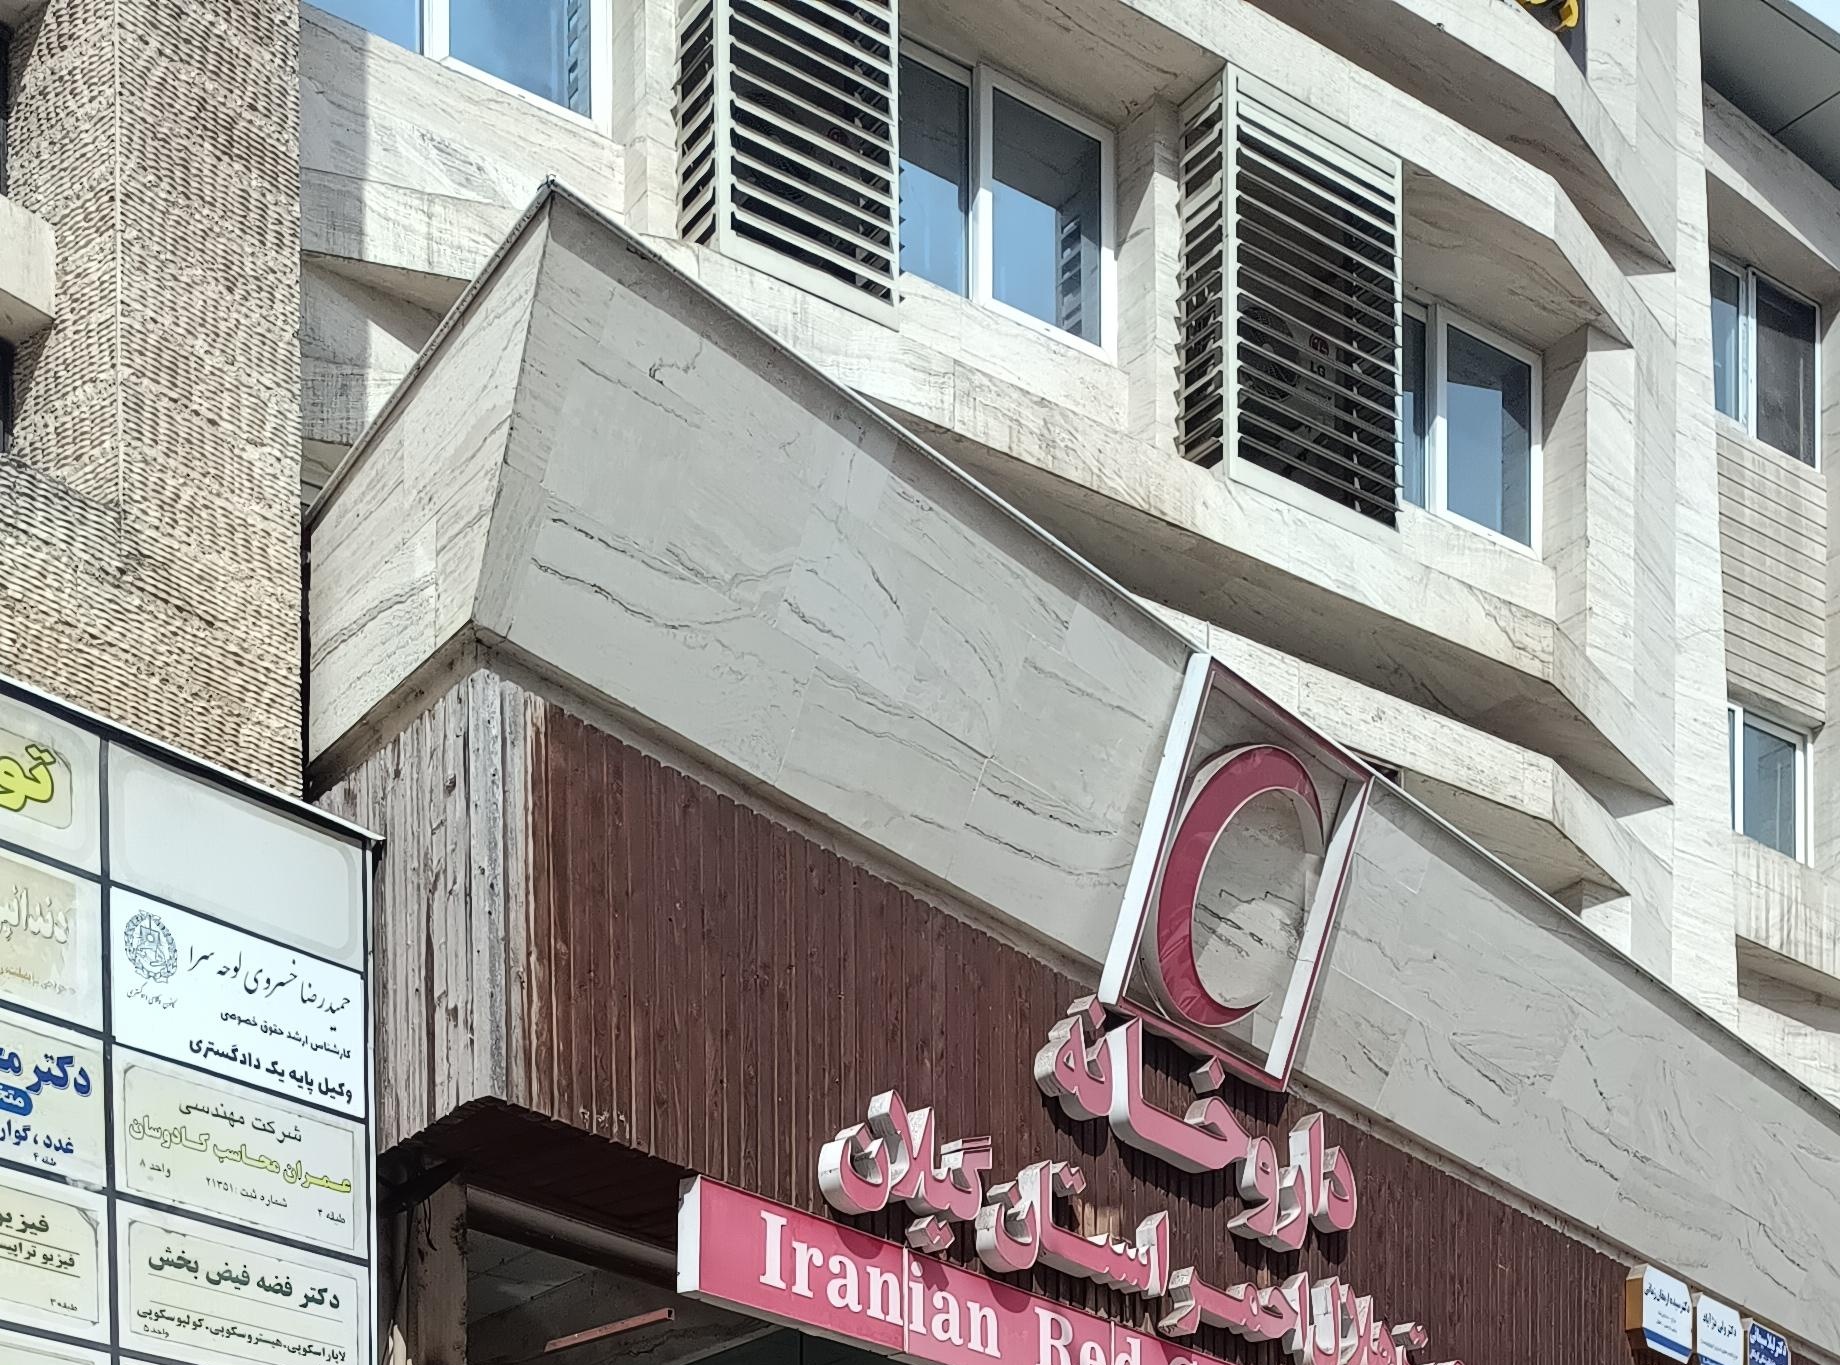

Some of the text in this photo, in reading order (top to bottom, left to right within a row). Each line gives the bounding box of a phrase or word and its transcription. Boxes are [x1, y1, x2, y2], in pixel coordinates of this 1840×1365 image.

[243, 958, 297, 998] خسروی
[220, 1009, 351, 1060] کارشناس ارشد حقوق خصوصی
[26, 1053, 92, 1097] دکتر
[189, 1037, 352, 1104] وکیل پایه یک دادگستری
[128, 1114, 210, 1152] کادوسان
[178, 1101, 302, 1144] شرکت مهندسی
[1034, 994, 1358, 1253] داروخانه
[139, 1158, 171, 1178] واحد ۸
[283, 1160, 351, 1194] عمران
[818, 1089, 993, 1254] گیلان
[259, 1192, 288, 1207] شماره
[975, 1159, 1169, 1299] استان
[148, 1245, 340, 1309] دکتر فضه فیض بخش
[758, 1208, 1002, 1359] Iranian
[151, 1326, 170, 1338] واحد
[1158, 1267, 1309, 1356] احمر
